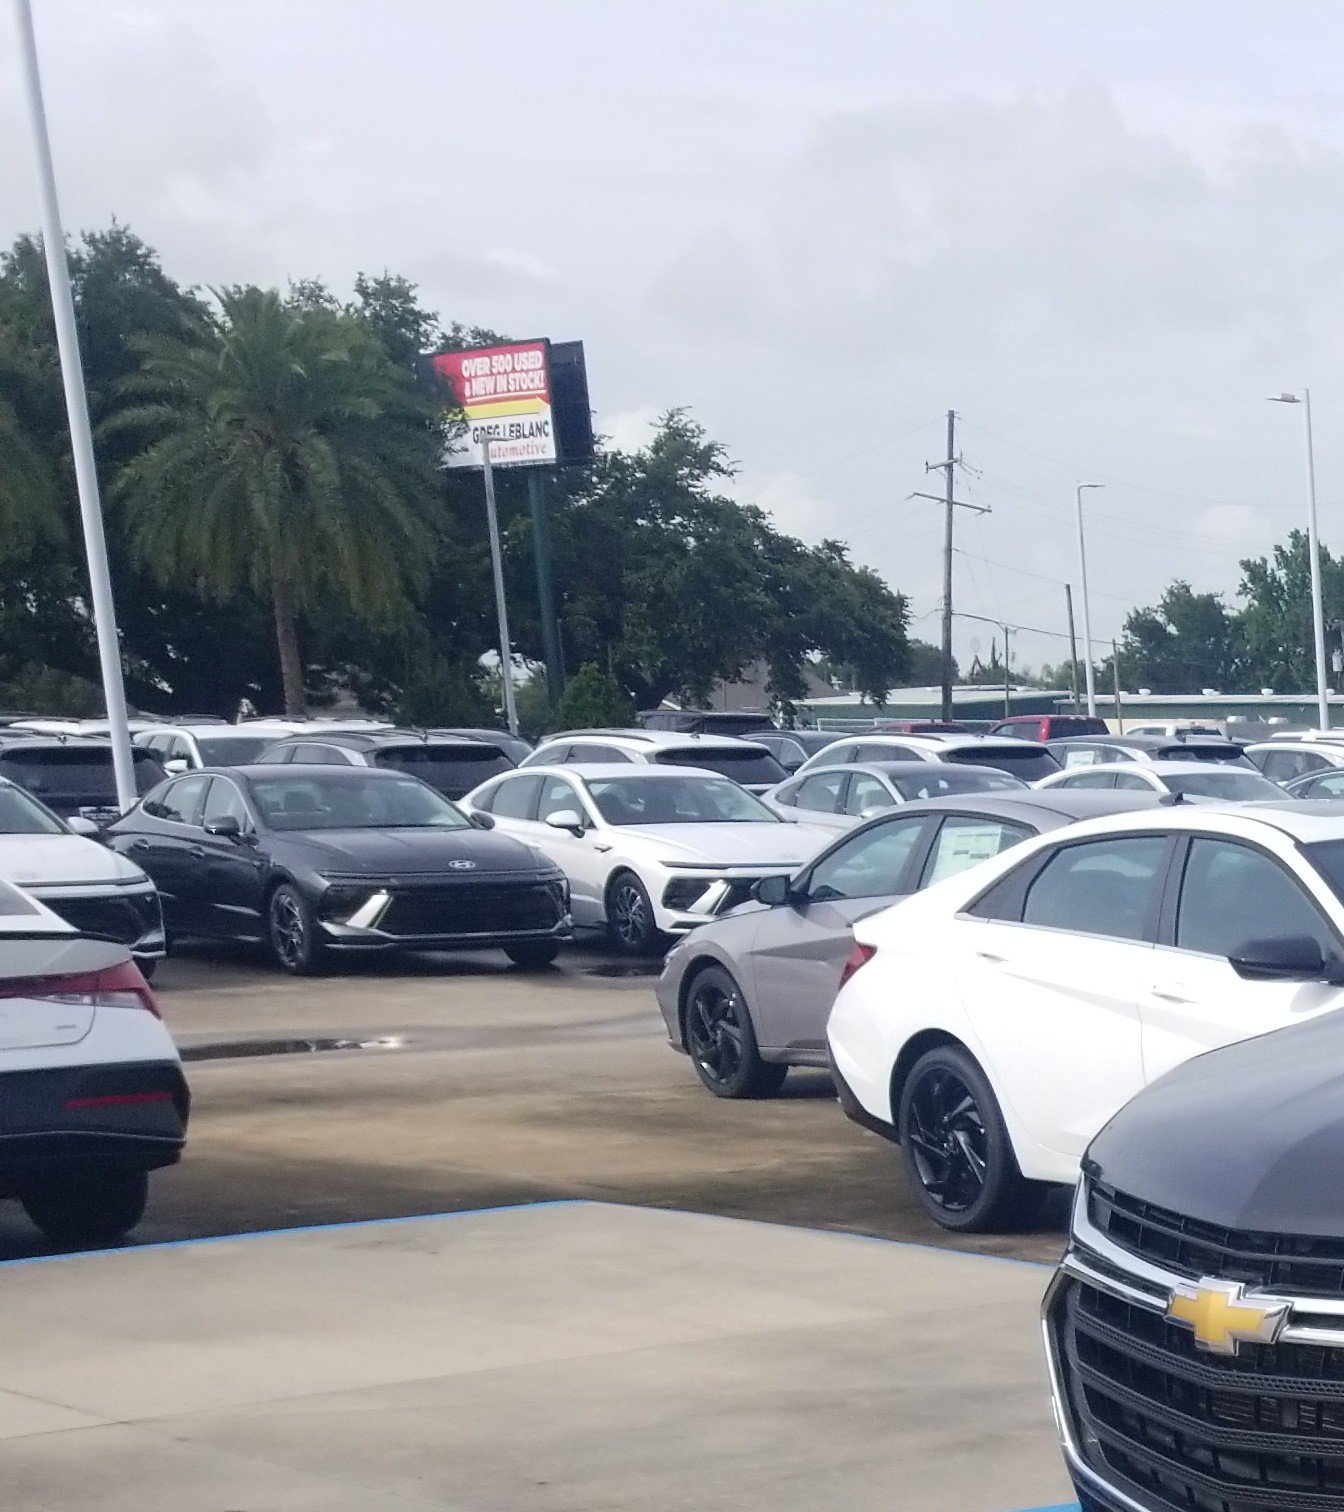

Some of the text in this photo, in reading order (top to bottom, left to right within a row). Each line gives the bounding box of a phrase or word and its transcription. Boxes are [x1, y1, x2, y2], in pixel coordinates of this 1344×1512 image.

[461, 350, 543, 378] OVER 500 USED
[471, 376, 495, 396] NEW
[496, 373, 508, 393] IN
[508, 370, 546, 391] STOCK!
[486, 442, 547, 459] utomotive
